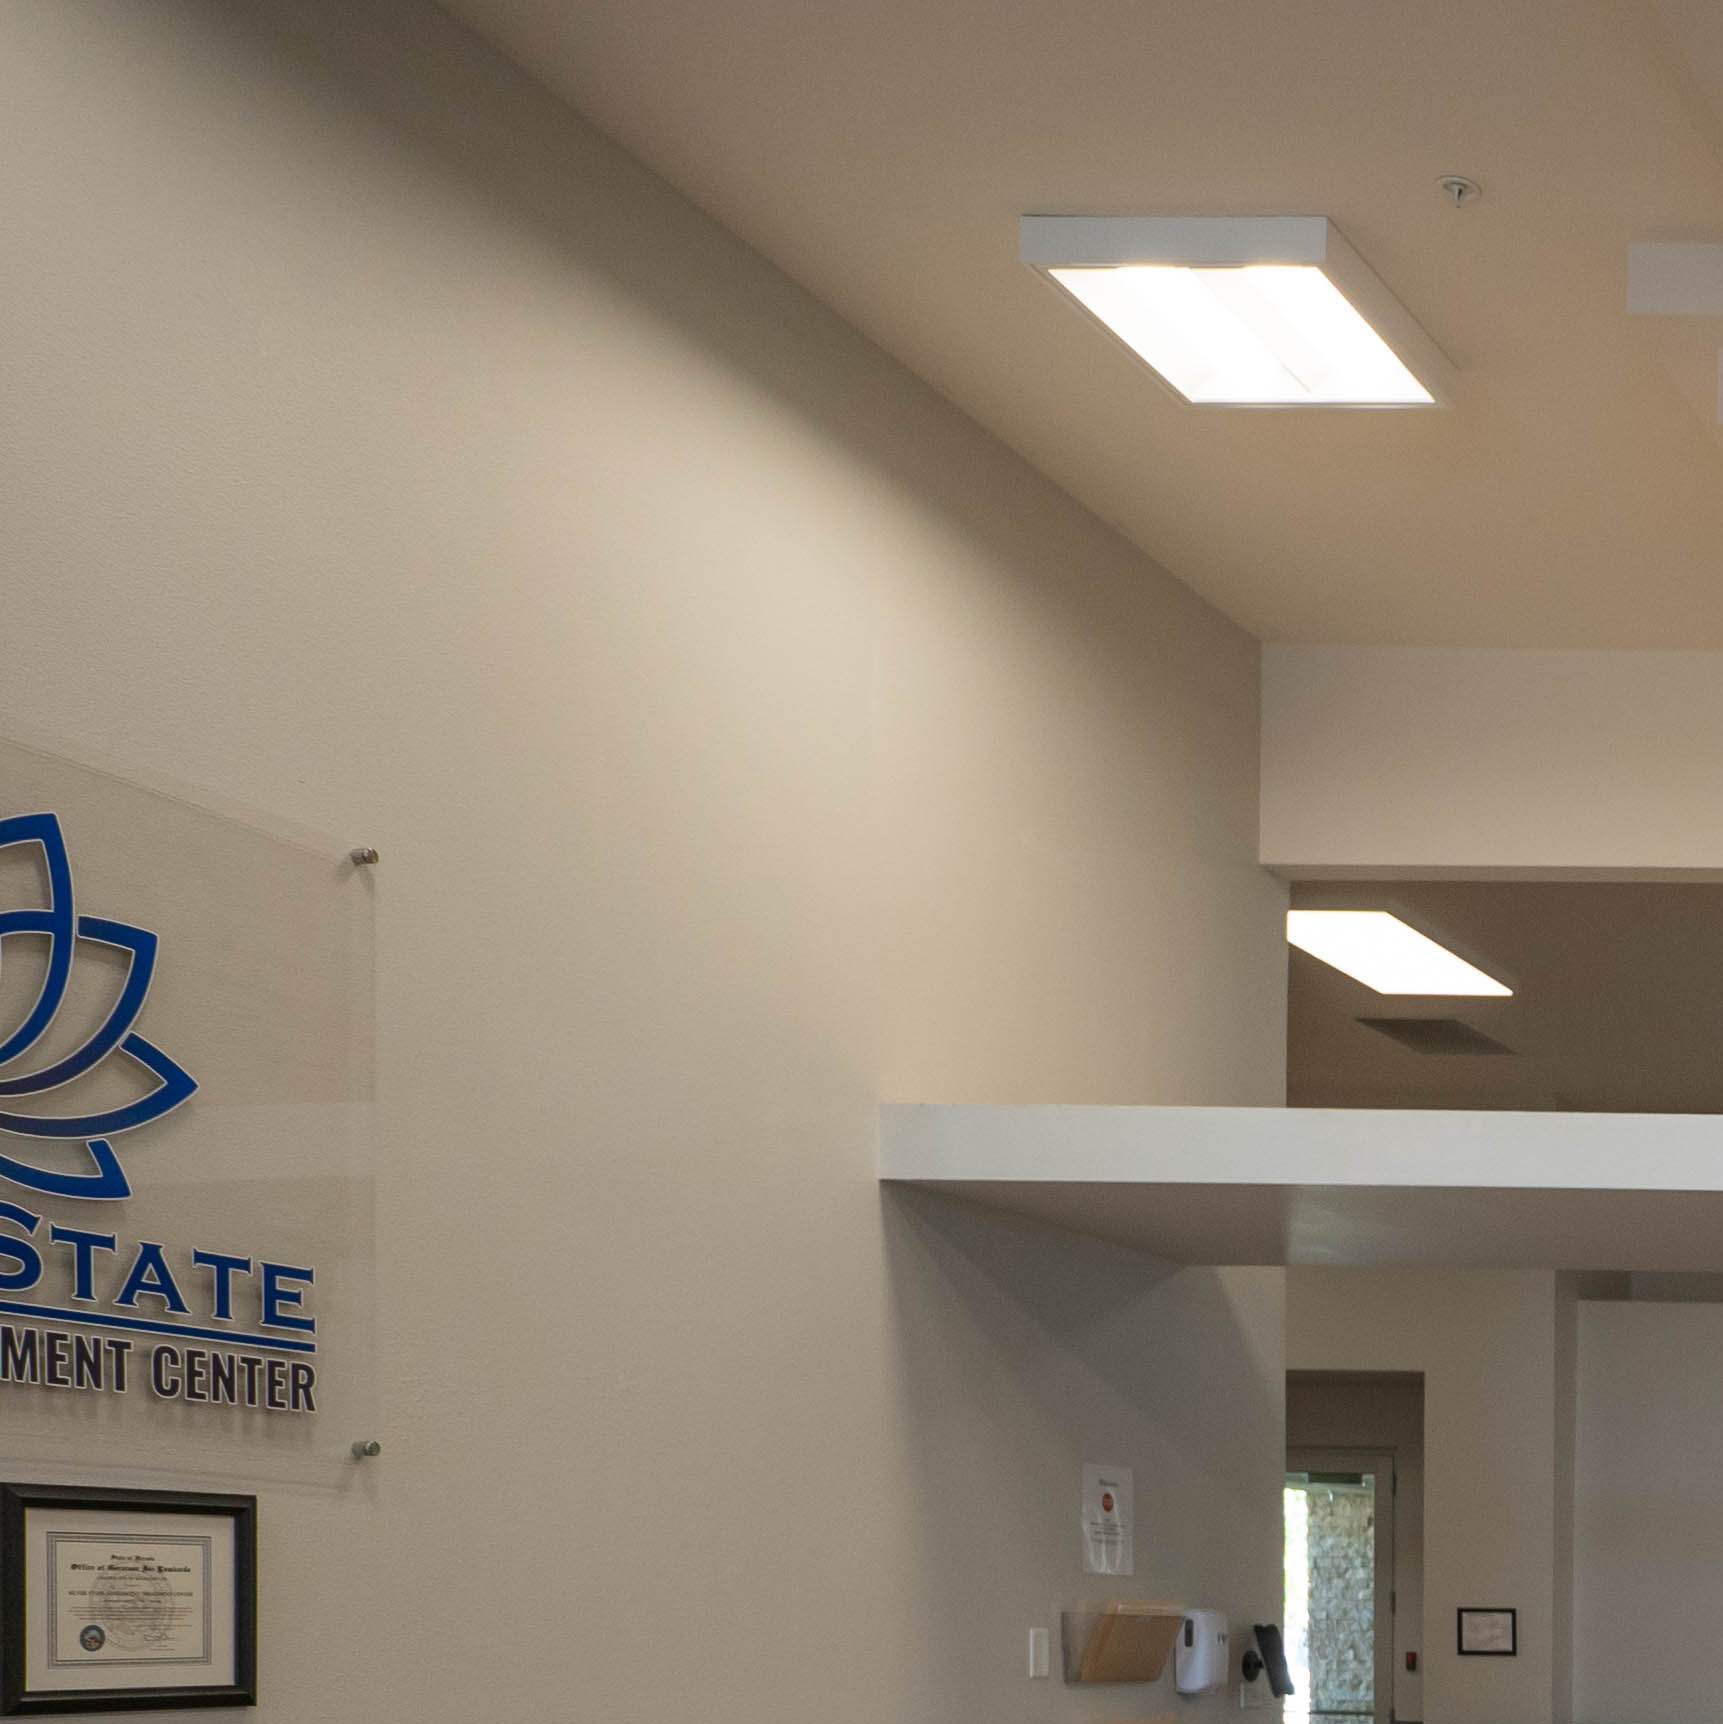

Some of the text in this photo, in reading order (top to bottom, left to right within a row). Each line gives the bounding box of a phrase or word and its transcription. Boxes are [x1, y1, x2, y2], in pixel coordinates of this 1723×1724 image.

[0, 1201, 316, 1334] STATE
[0, 1325, 317, 1413] MENT CENTER
